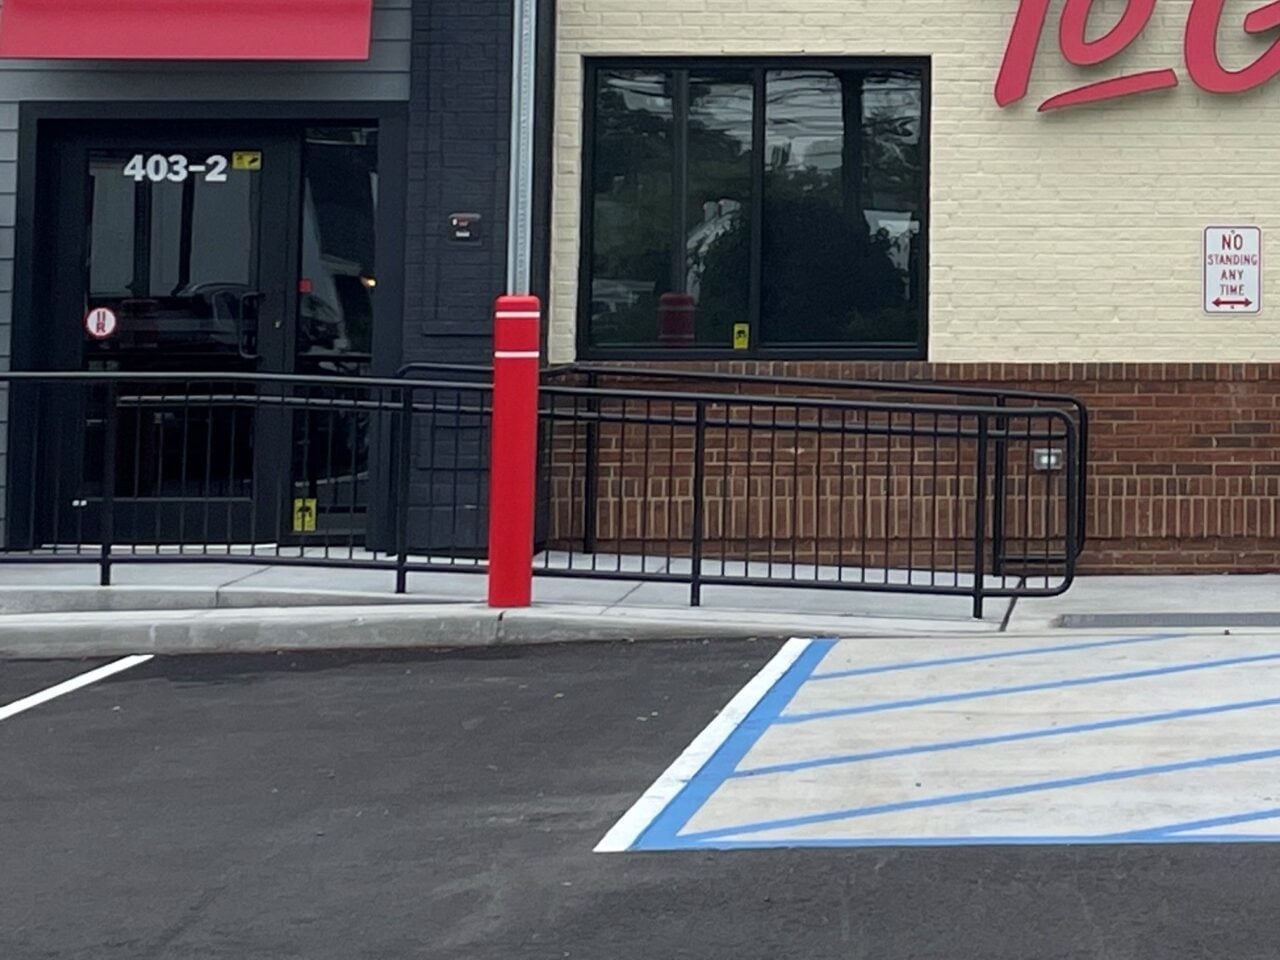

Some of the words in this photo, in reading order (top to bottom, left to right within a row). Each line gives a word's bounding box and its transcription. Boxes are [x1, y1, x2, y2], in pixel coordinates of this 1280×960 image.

[123, 154, 228, 182] 403-2
[1221, 233, 1243, 251] NO
[1207, 253, 1258, 266] STANDING
[1220, 269, 1244, 281] ANY
[1219, 284, 1245, 296] TIME
